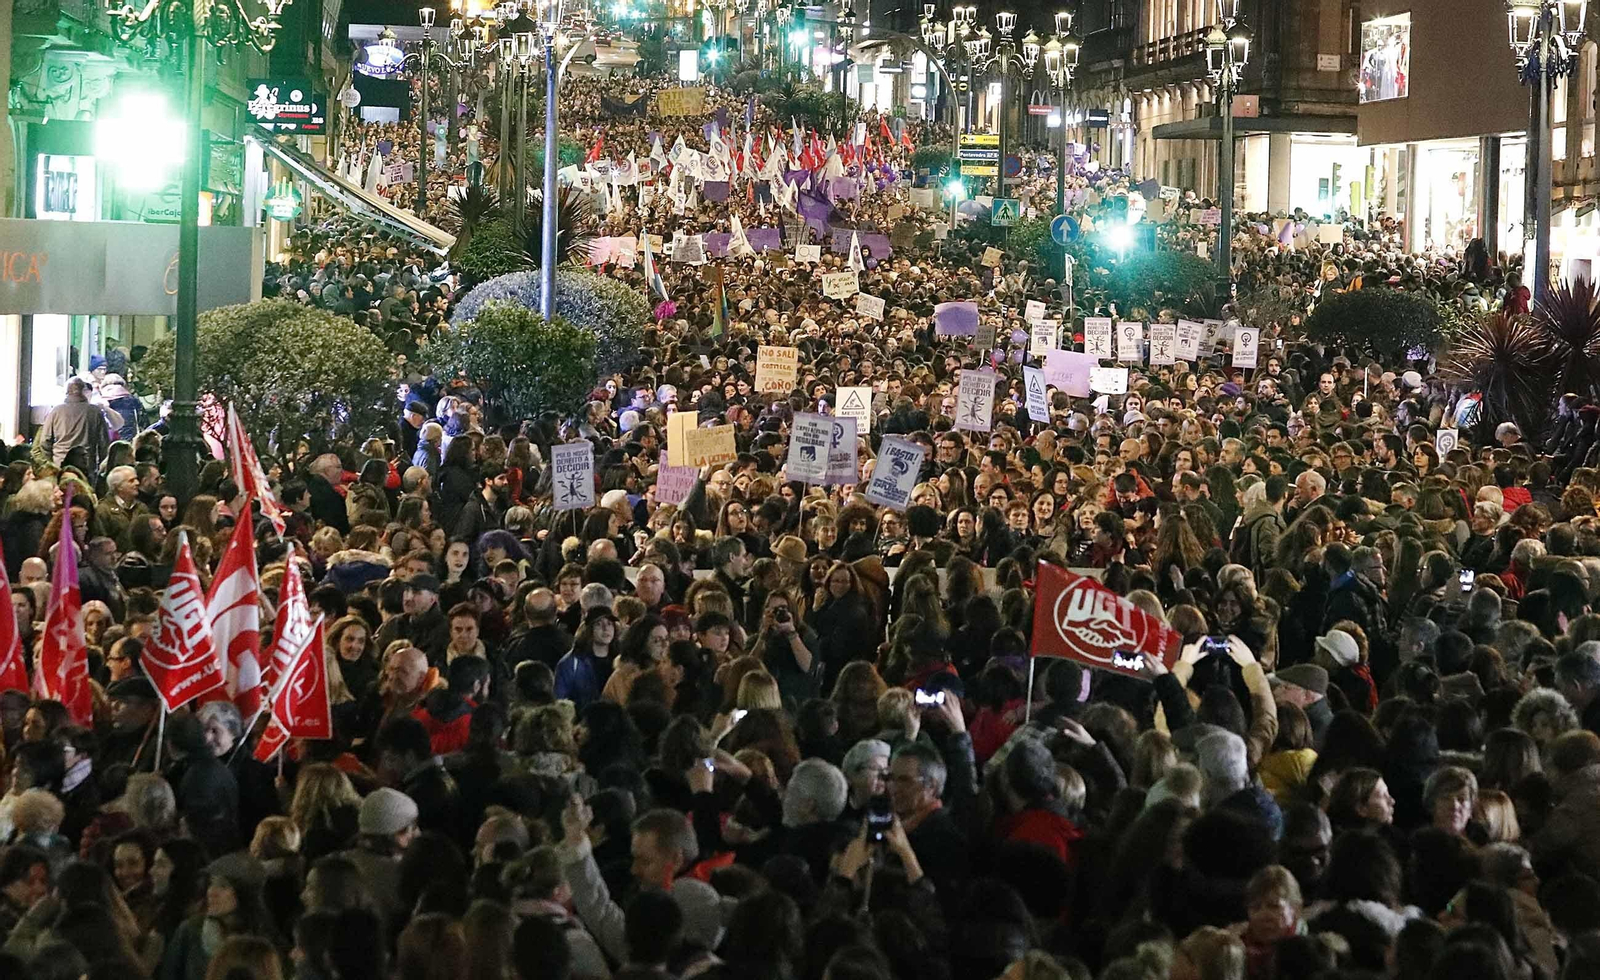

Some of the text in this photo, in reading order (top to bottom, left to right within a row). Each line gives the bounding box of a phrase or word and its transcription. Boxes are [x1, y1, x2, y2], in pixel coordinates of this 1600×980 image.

[0, 252, 41, 283] ICA
[762, 349, 774, 357] NO
[962, 387, 991, 397] DECIDIR
[694, 456, 707, 466] LA
[885, 443, 919, 465] ¡BASTA!
[556, 462, 590, 473] DECIDIR
[161, 579, 214, 650] UGT
[1066, 588, 1135, 632] UGT
